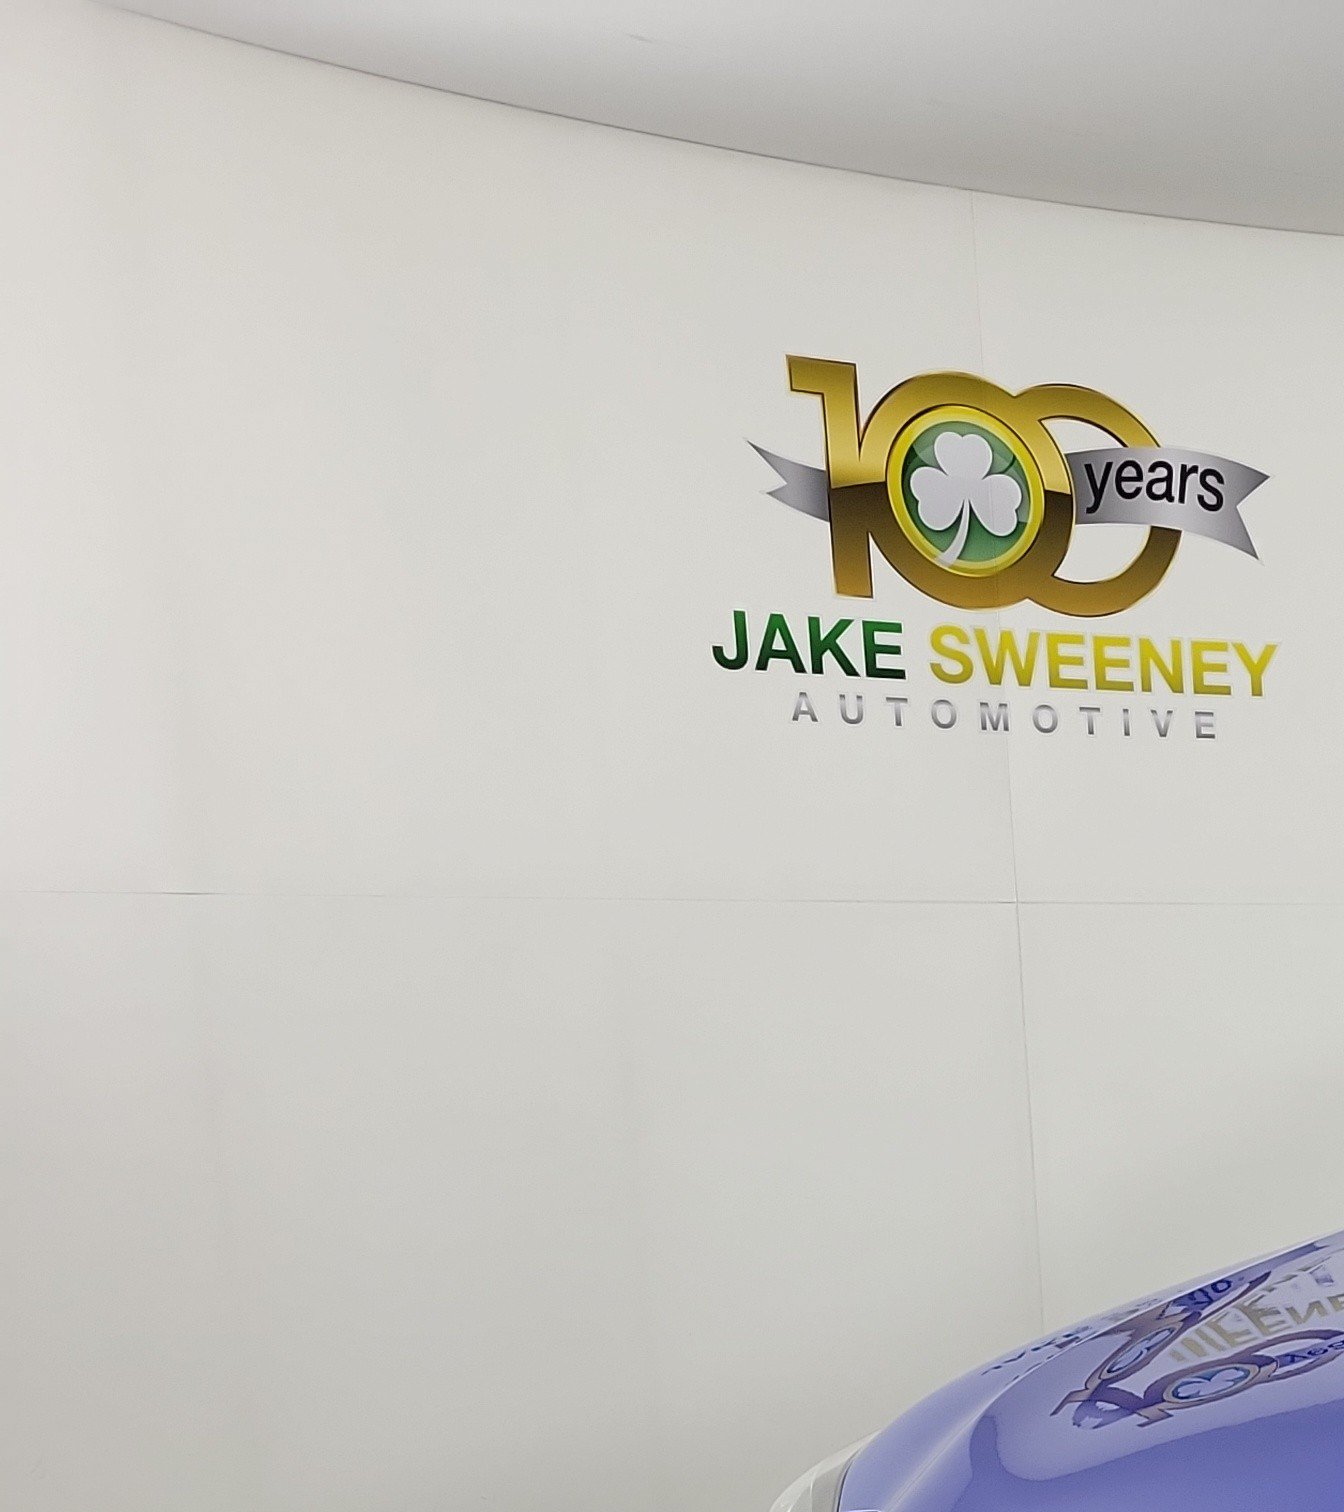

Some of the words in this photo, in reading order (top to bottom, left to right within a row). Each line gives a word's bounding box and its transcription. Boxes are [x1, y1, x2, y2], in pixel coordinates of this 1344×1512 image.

[785, 354, 1182, 618] 100
[1083, 456, 1226, 515] years
[711, 609, 906, 680] JAKE
[929, 623, 1278, 697] SWEENEY
[791, 691, 1217, 741] AUTOMOTIVE
